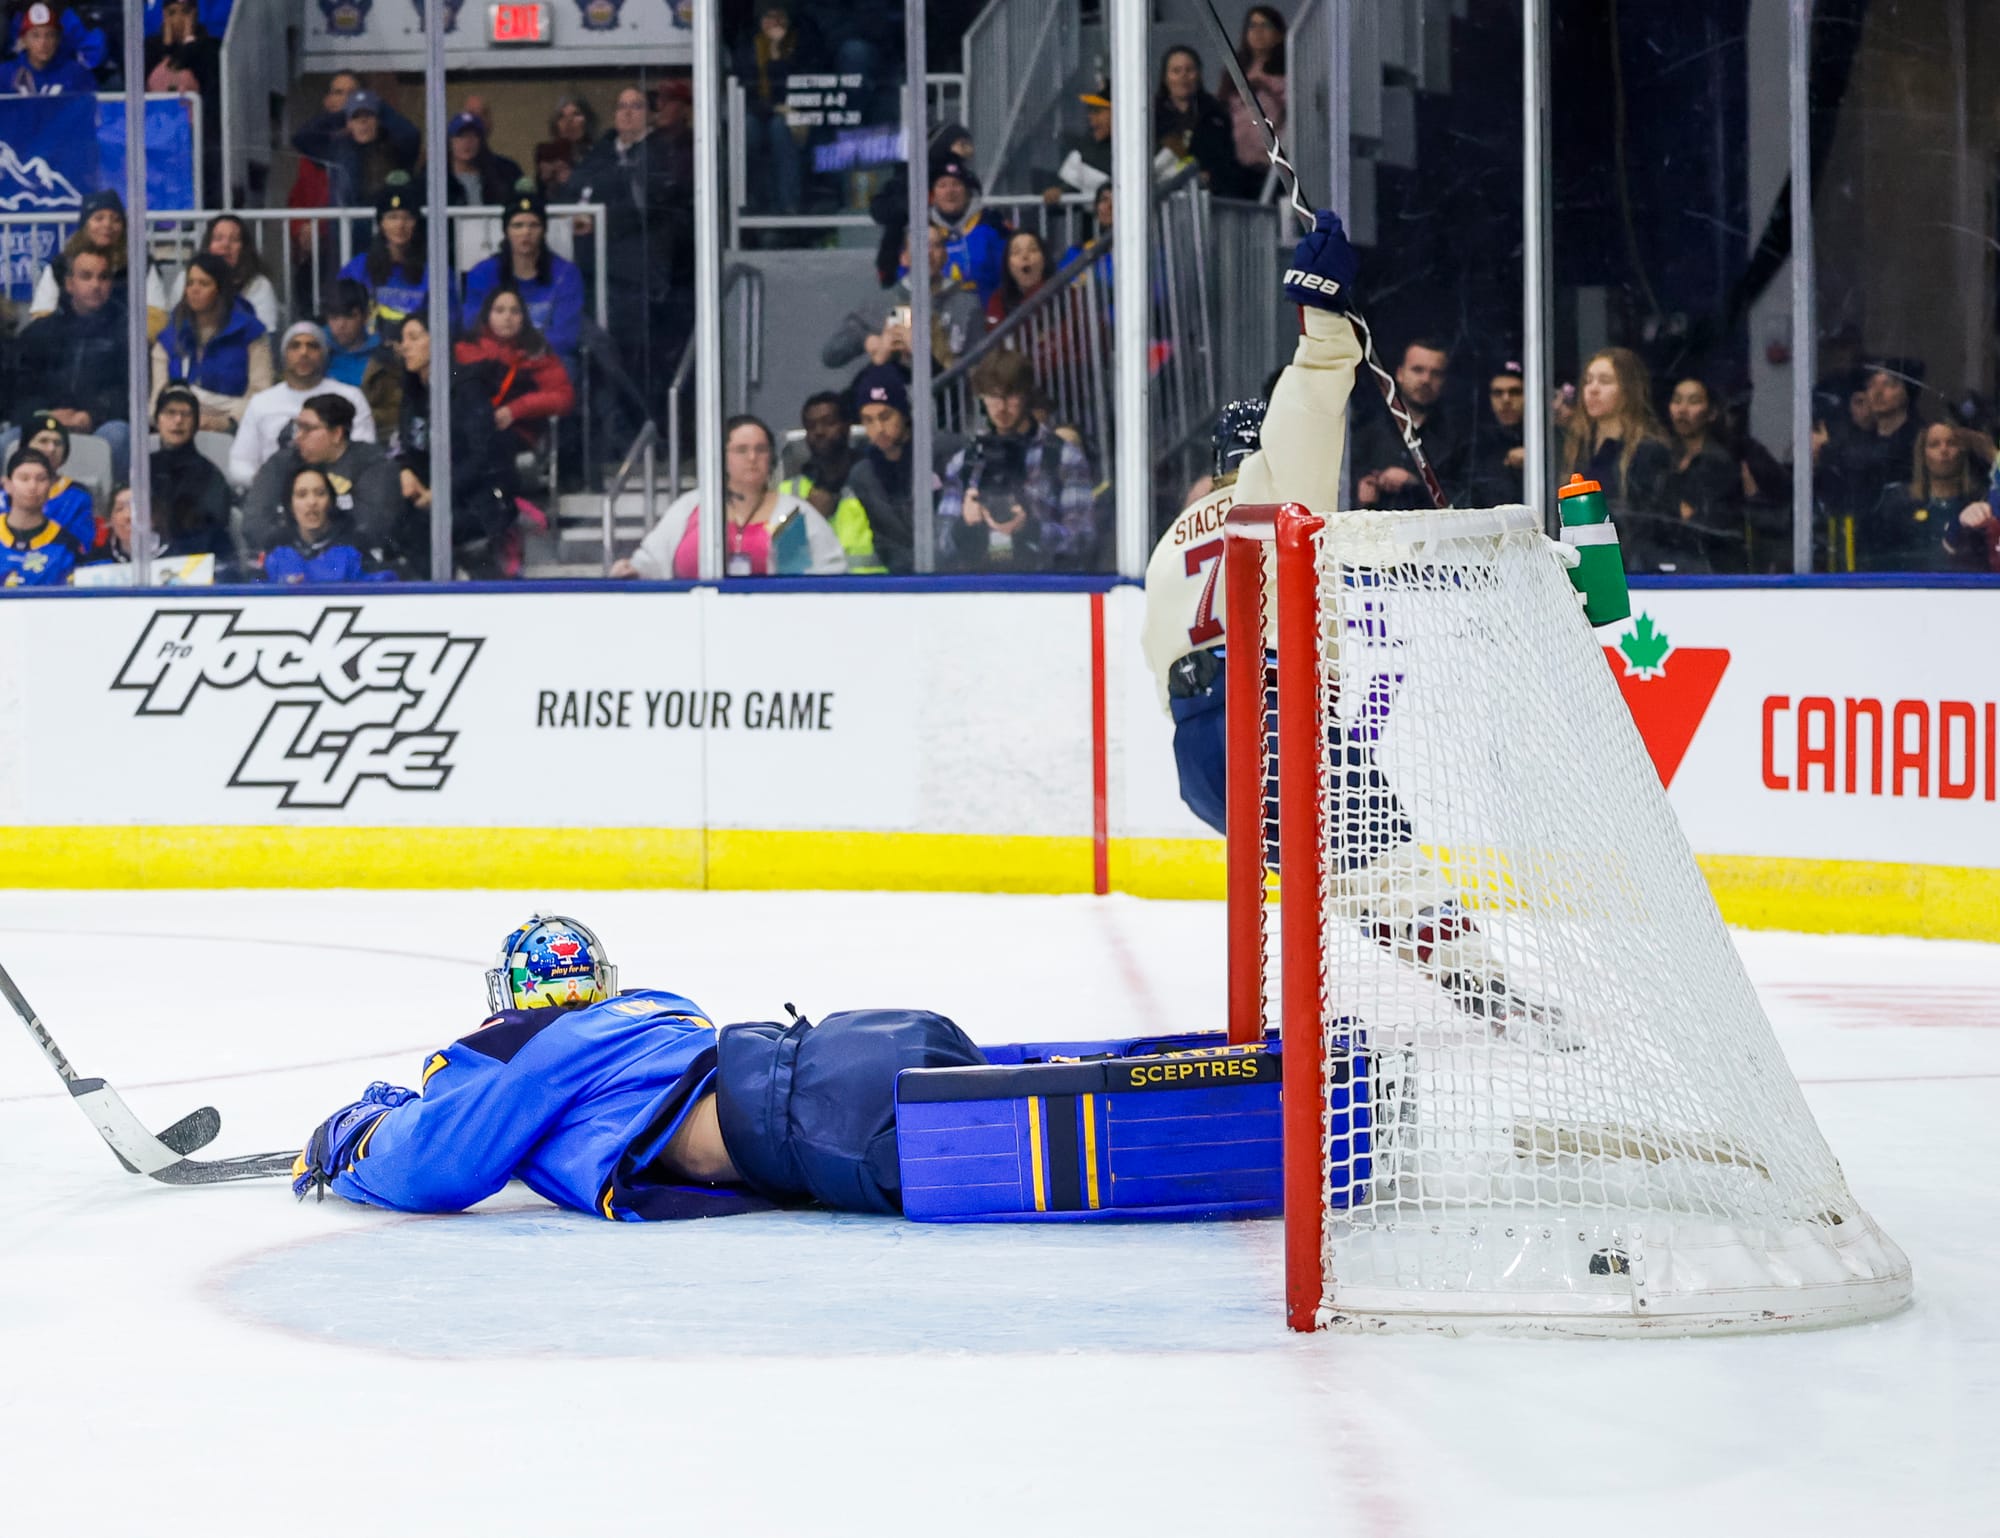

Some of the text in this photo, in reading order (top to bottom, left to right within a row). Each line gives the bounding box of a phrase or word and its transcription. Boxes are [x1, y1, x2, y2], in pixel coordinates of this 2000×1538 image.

[494, 5, 540, 41] EXIT
[1174, 497, 1233, 545] STACE
[157, 640, 194, 659] Pro
[537, 690, 834, 731] RAISE YOUR GAME
[551, 965, 568, 977] play
[569, 964, 579, 973] for
[1130, 1058, 1258, 1087] SCEPTRES
